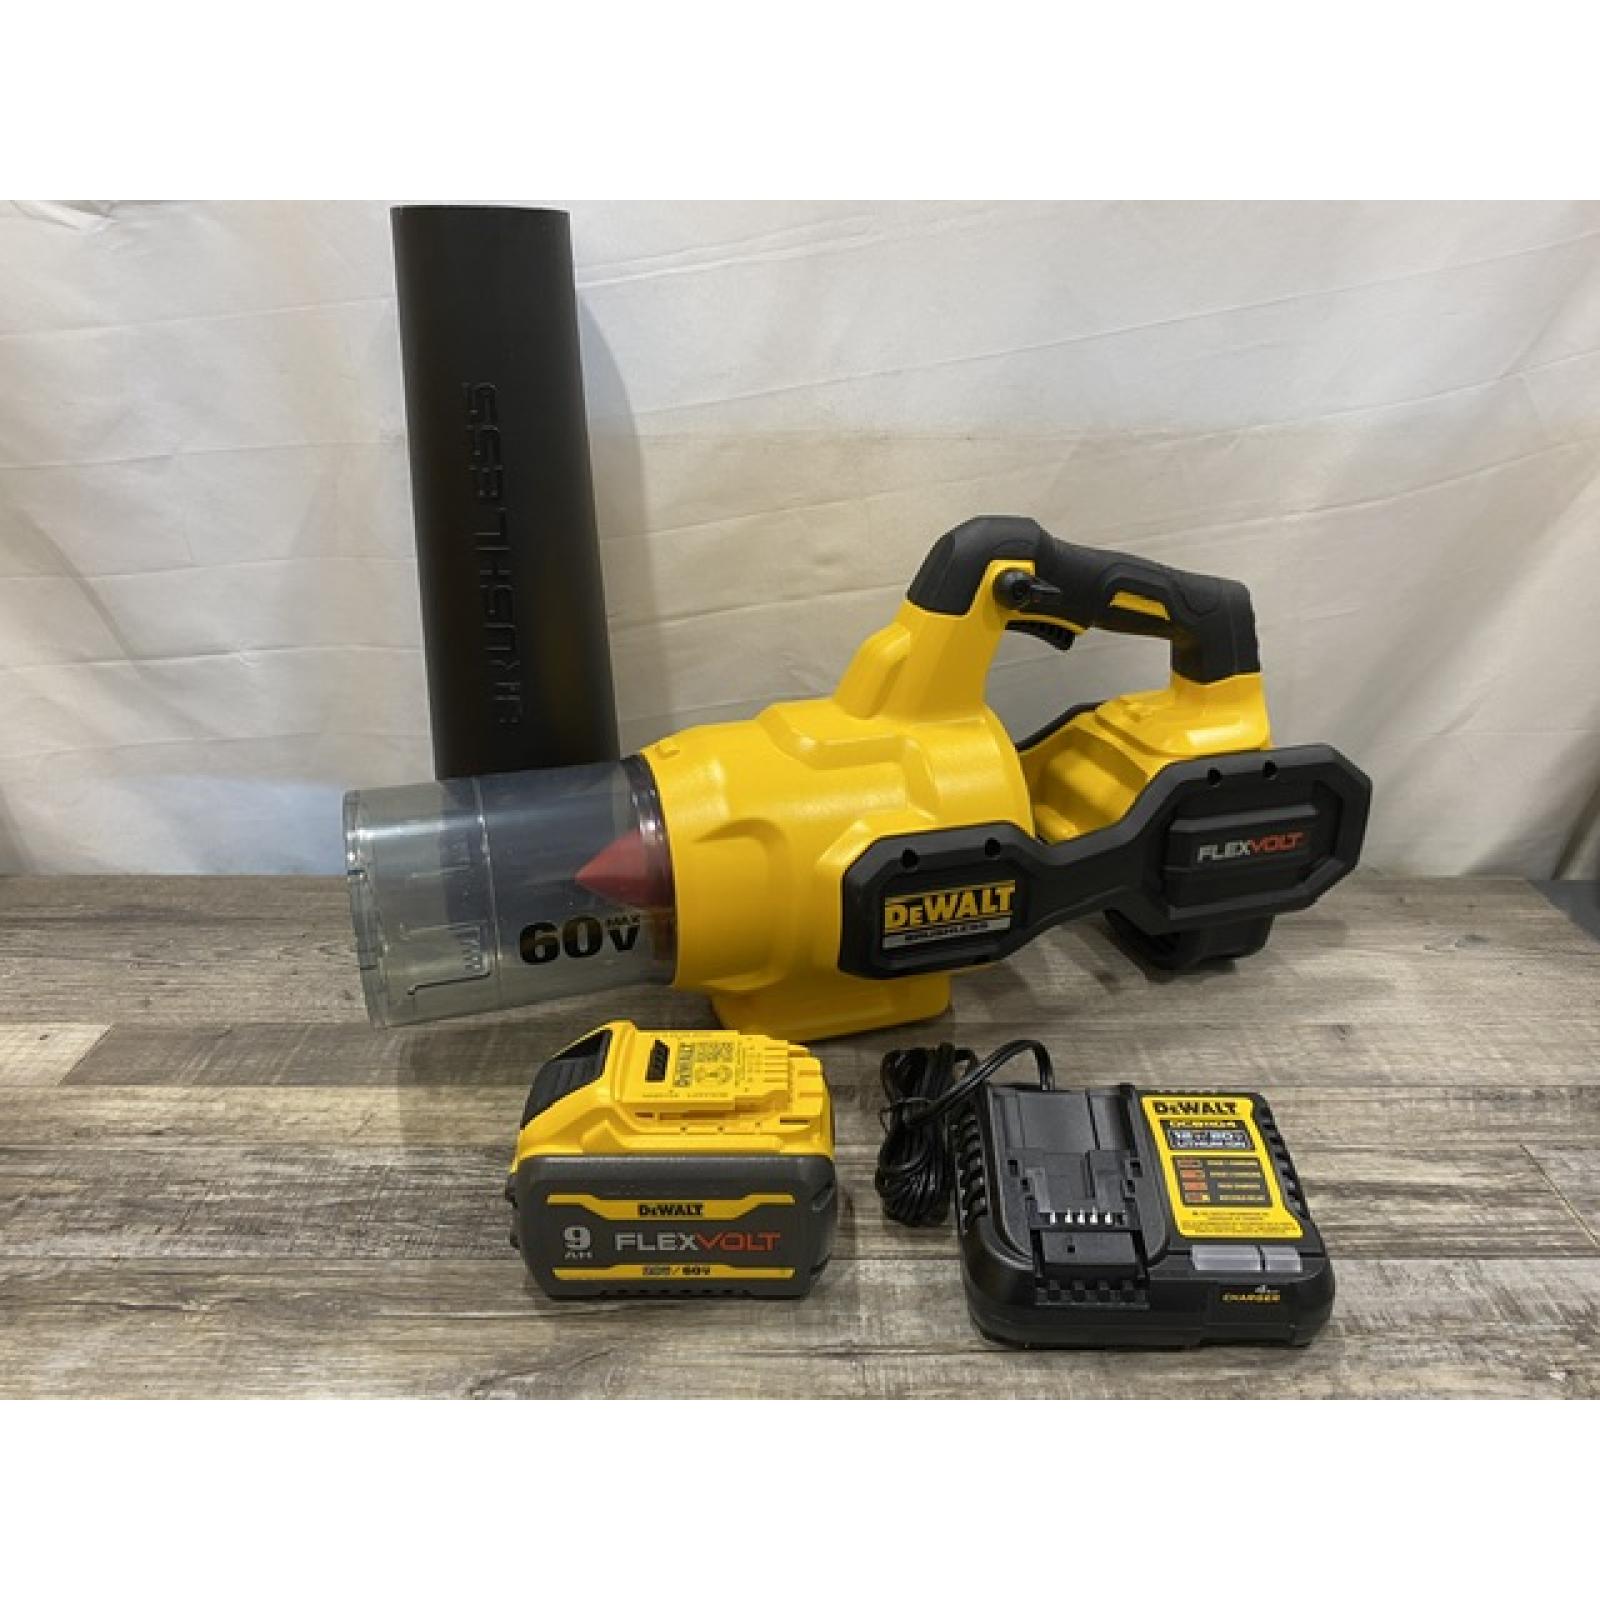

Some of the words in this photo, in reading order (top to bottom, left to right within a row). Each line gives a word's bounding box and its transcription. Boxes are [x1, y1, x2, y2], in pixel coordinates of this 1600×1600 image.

[1197, 831, 1305, 863] FLEXVOLT
[563, 1225, 592, 1249] 9
[614, 1231, 781, 1252] FLEXVOLT
